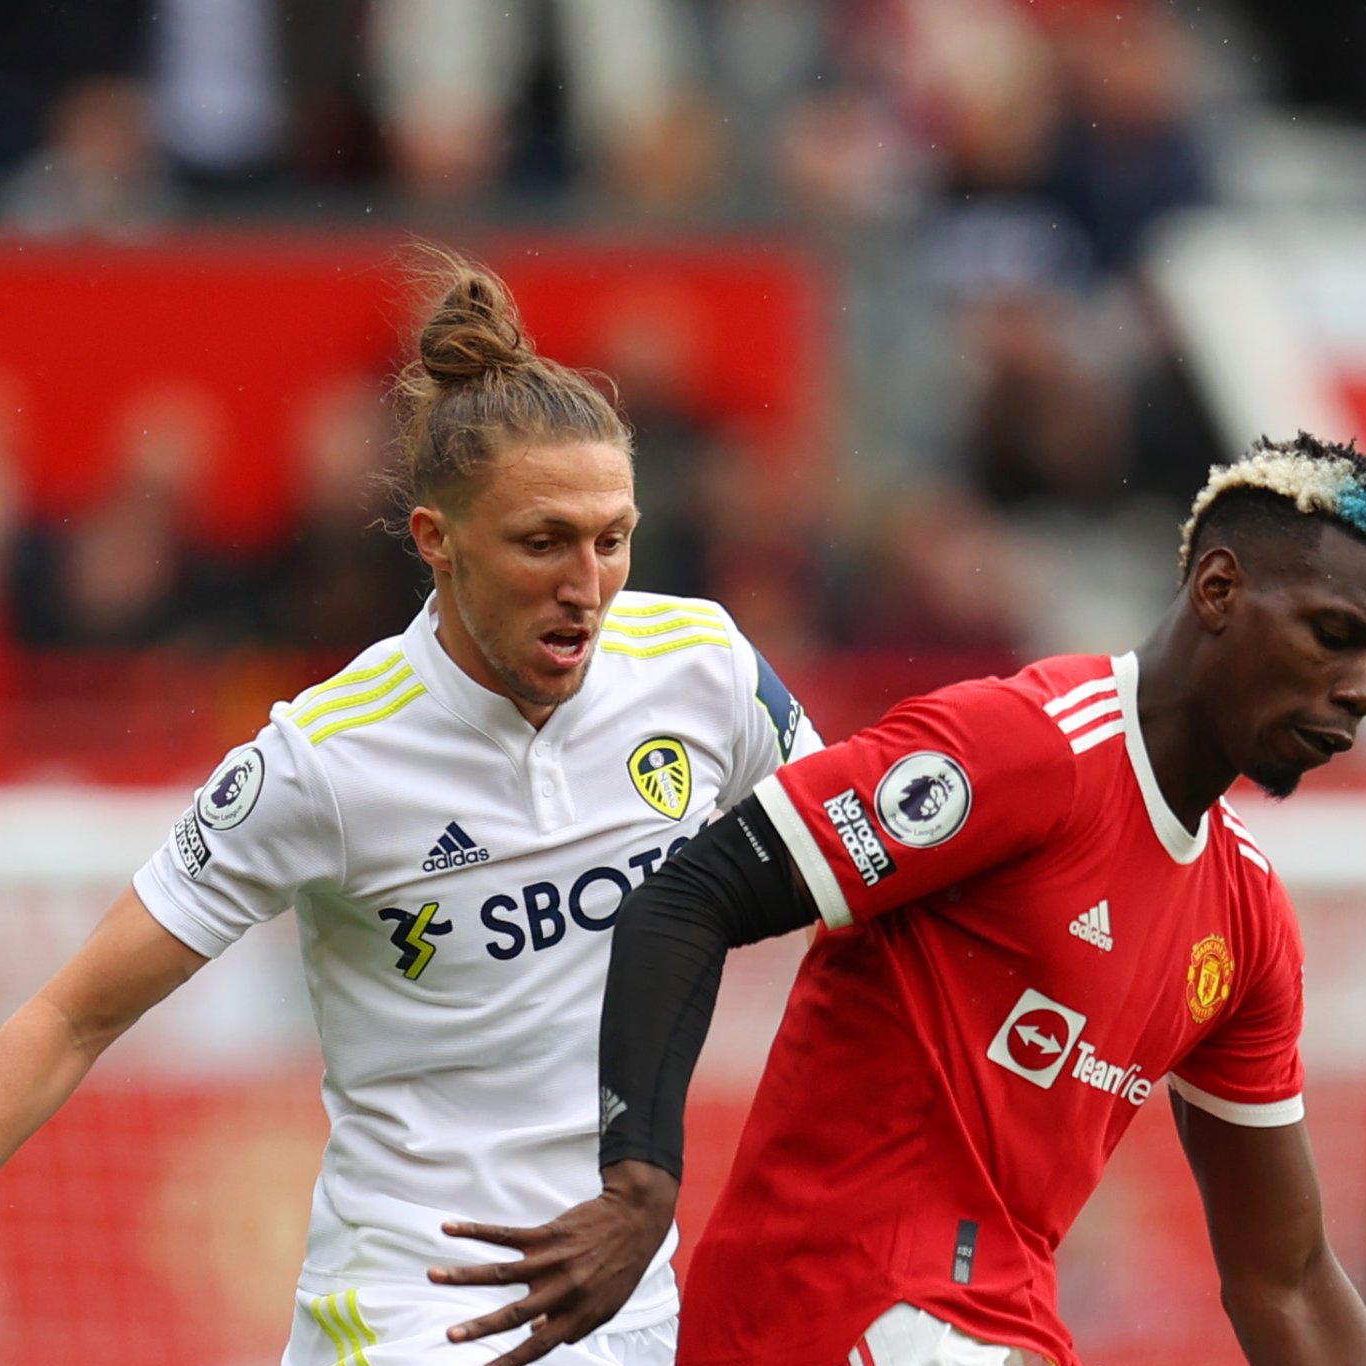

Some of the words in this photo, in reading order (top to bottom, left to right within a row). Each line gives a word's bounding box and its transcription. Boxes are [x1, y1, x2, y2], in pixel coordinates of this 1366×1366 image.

[422, 847, 490, 873] adidas
[837, 823, 880, 887] racism
[838, 788, 862, 820] No
[852, 818, 889, 870] room
[480, 818, 710, 961] SBOT
[1068, 918, 1114, 952] adidas
